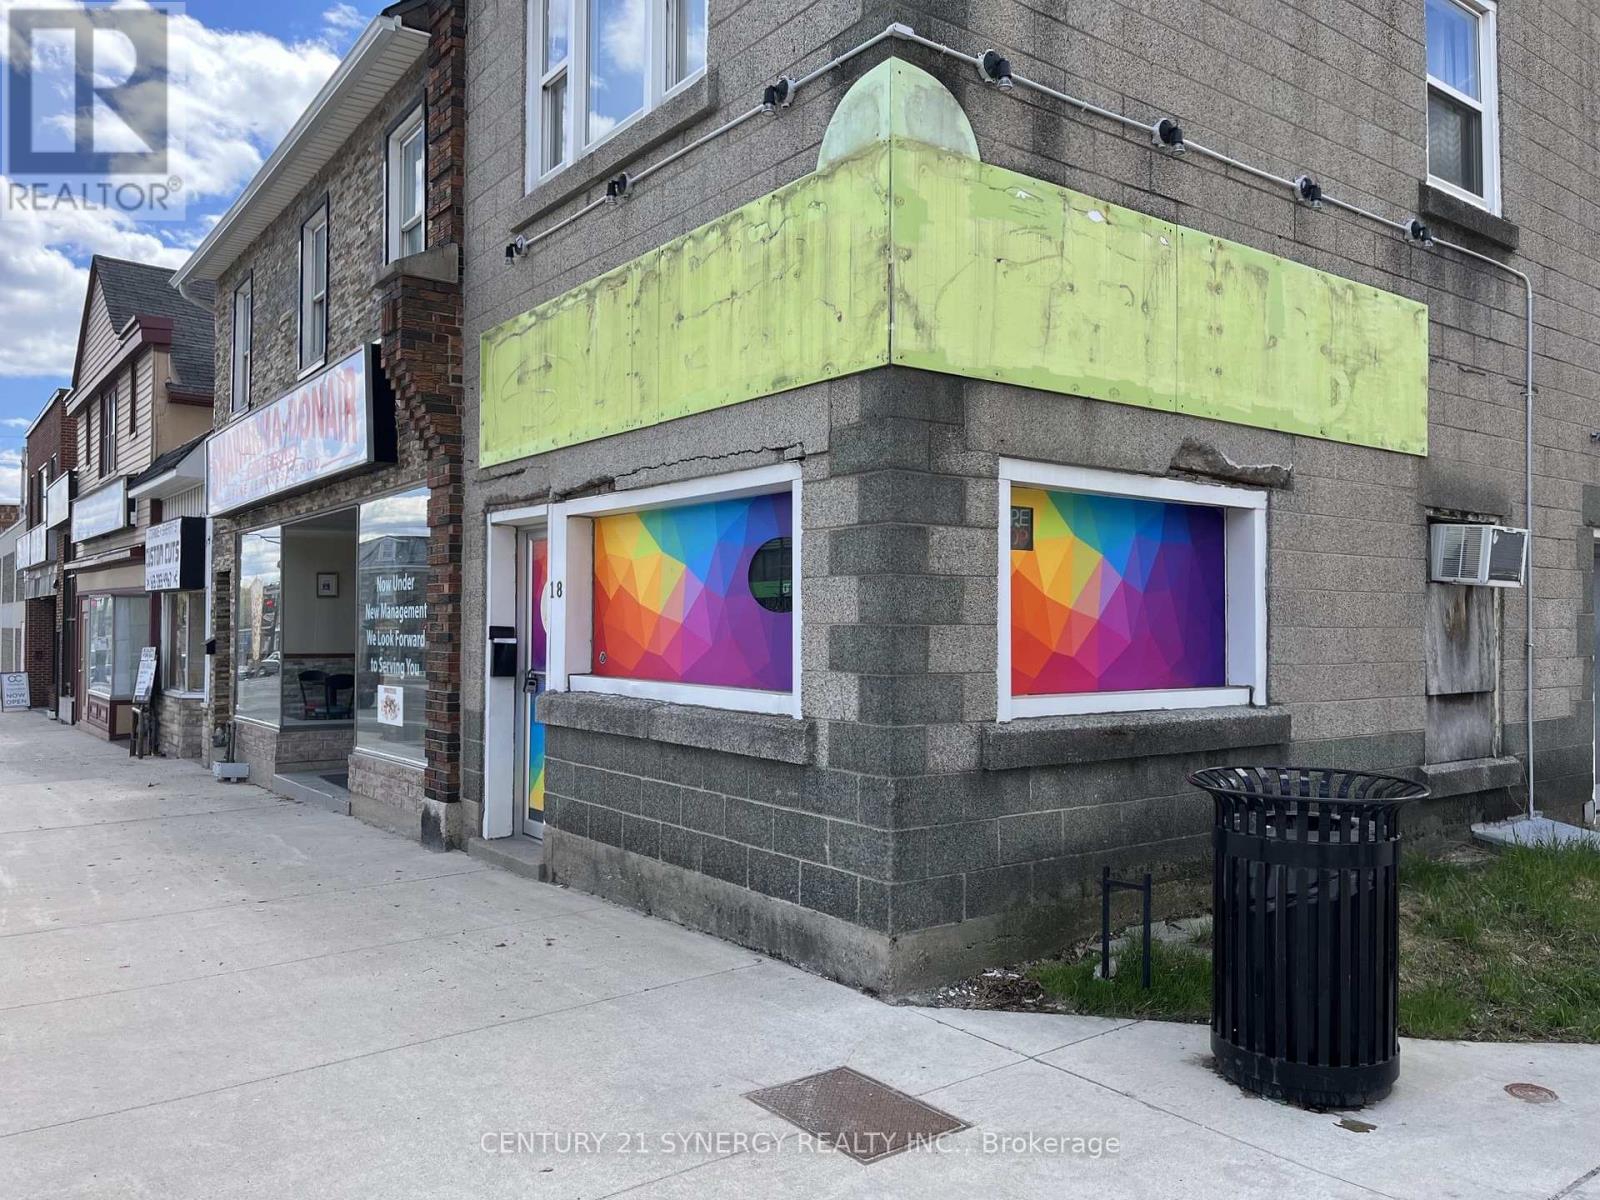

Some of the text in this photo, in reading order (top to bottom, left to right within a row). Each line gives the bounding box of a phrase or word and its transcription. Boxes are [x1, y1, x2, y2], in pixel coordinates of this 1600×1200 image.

[165, 540, 179, 564] CUTS
[376, 572, 415, 593] Now Under
[550, 580, 563, 599] 18
[365, 602, 428, 624] New Management
[366, 629, 426, 648] We Look Forward
[370, 657, 378, 673] to
[378, 656, 405, 680] Serving
